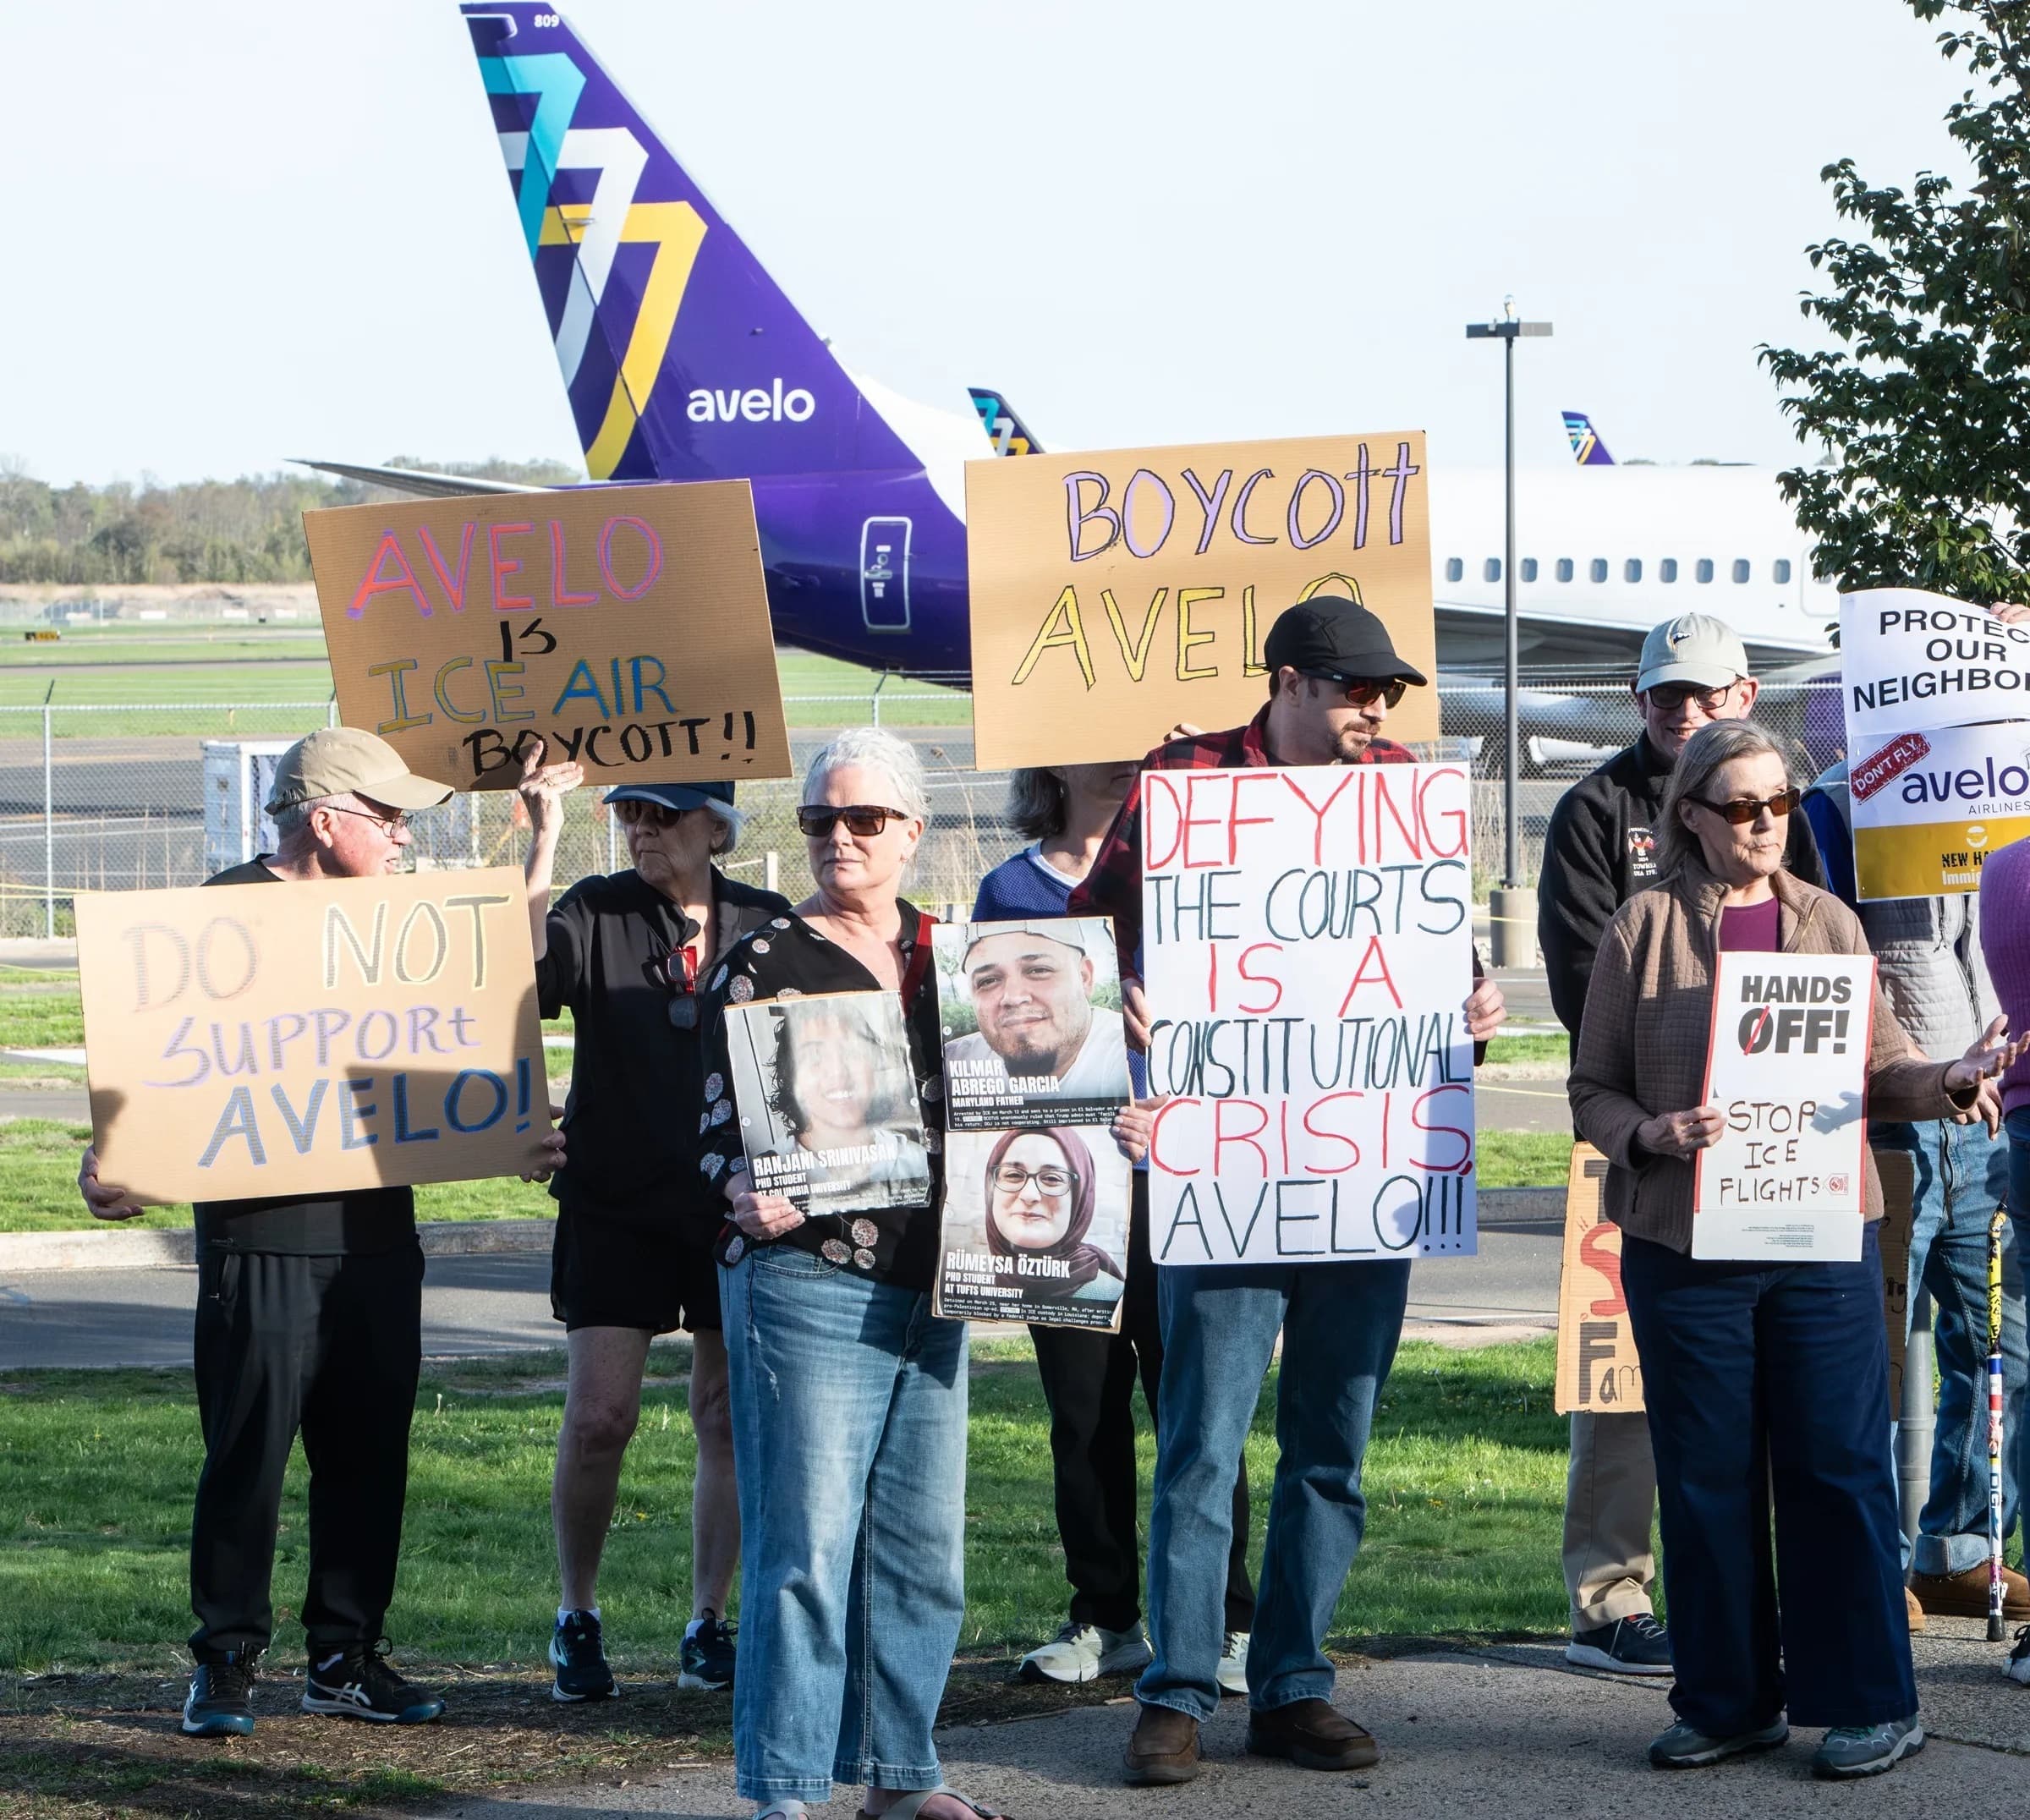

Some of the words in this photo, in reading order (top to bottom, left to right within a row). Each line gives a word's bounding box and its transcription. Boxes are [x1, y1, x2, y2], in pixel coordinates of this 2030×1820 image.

[534, 14, 560, 28] 809
[687, 378, 815, 423] avelo
[346, 515, 664, 620] AVELO
[1012, 573, 1363, 692] AVEL
[1925, 639, 2006, 662] OUR
[369, 655, 535, 735] ICE
[553, 655, 675, 719] AIR
[1856, 757, 1892, 792] DON'T
[1893, 738, 1917, 762] FLY
[1902, 756, 2029, 804] avelo
[1146, 768, 1468, 870] DEFYING
[1941, 852, 1967, 868] NEW
[1144, 869, 1242, 945] THE
[1265, 859, 1466, 942] COURTS
[122, 914, 262, 1014] DO
[321, 893, 514, 991] NOT
[1209, 942, 1284, 1013] IS
[1338, 935, 1403, 1017] A
[1741, 975, 1852, 1004] HANDS
[1737, 1006, 1851, 1055] OFF!
[949, 1059, 1002, 1077] KILMAR
[1147, 1012, 1471, 1098] CONSTITUTIONAL
[952, 1076, 1005, 1096] ABREGO
[1008, 1075, 1060, 1094] GARCIA
[952, 1096, 995, 1108] MARYLAND
[996, 1095, 1024, 1106] FATHER
[197, 1057, 532, 1168] AVELO!
[1727, 1099, 1817, 1133] STOP
[752, 1151, 815, 1177] RANJANI
[1744, 1138, 1799, 1170] ICE
[755, 1176, 771, 1189] PHD
[773, 1172, 807, 1187] STUDENT
[769, 1185, 809, 1198] COLUMBIA
[810, 1180, 852, 1193] UNIVERSITY
[1720, 1176, 1820, 1206] FLIGHTS
[945, 1271, 961, 1282] PHD
[963, 1273, 996, 1286] STUDENT
[946, 1248, 1014, 1275] RÜMEYSA
[1018, 1253, 1071, 1279] ÖZTÜRK
[944, 1284, 955, 1294] AT
[957, 1285, 979, 1296] TUFTS
[979, 1286, 1023, 1299] UNIVERSITY
